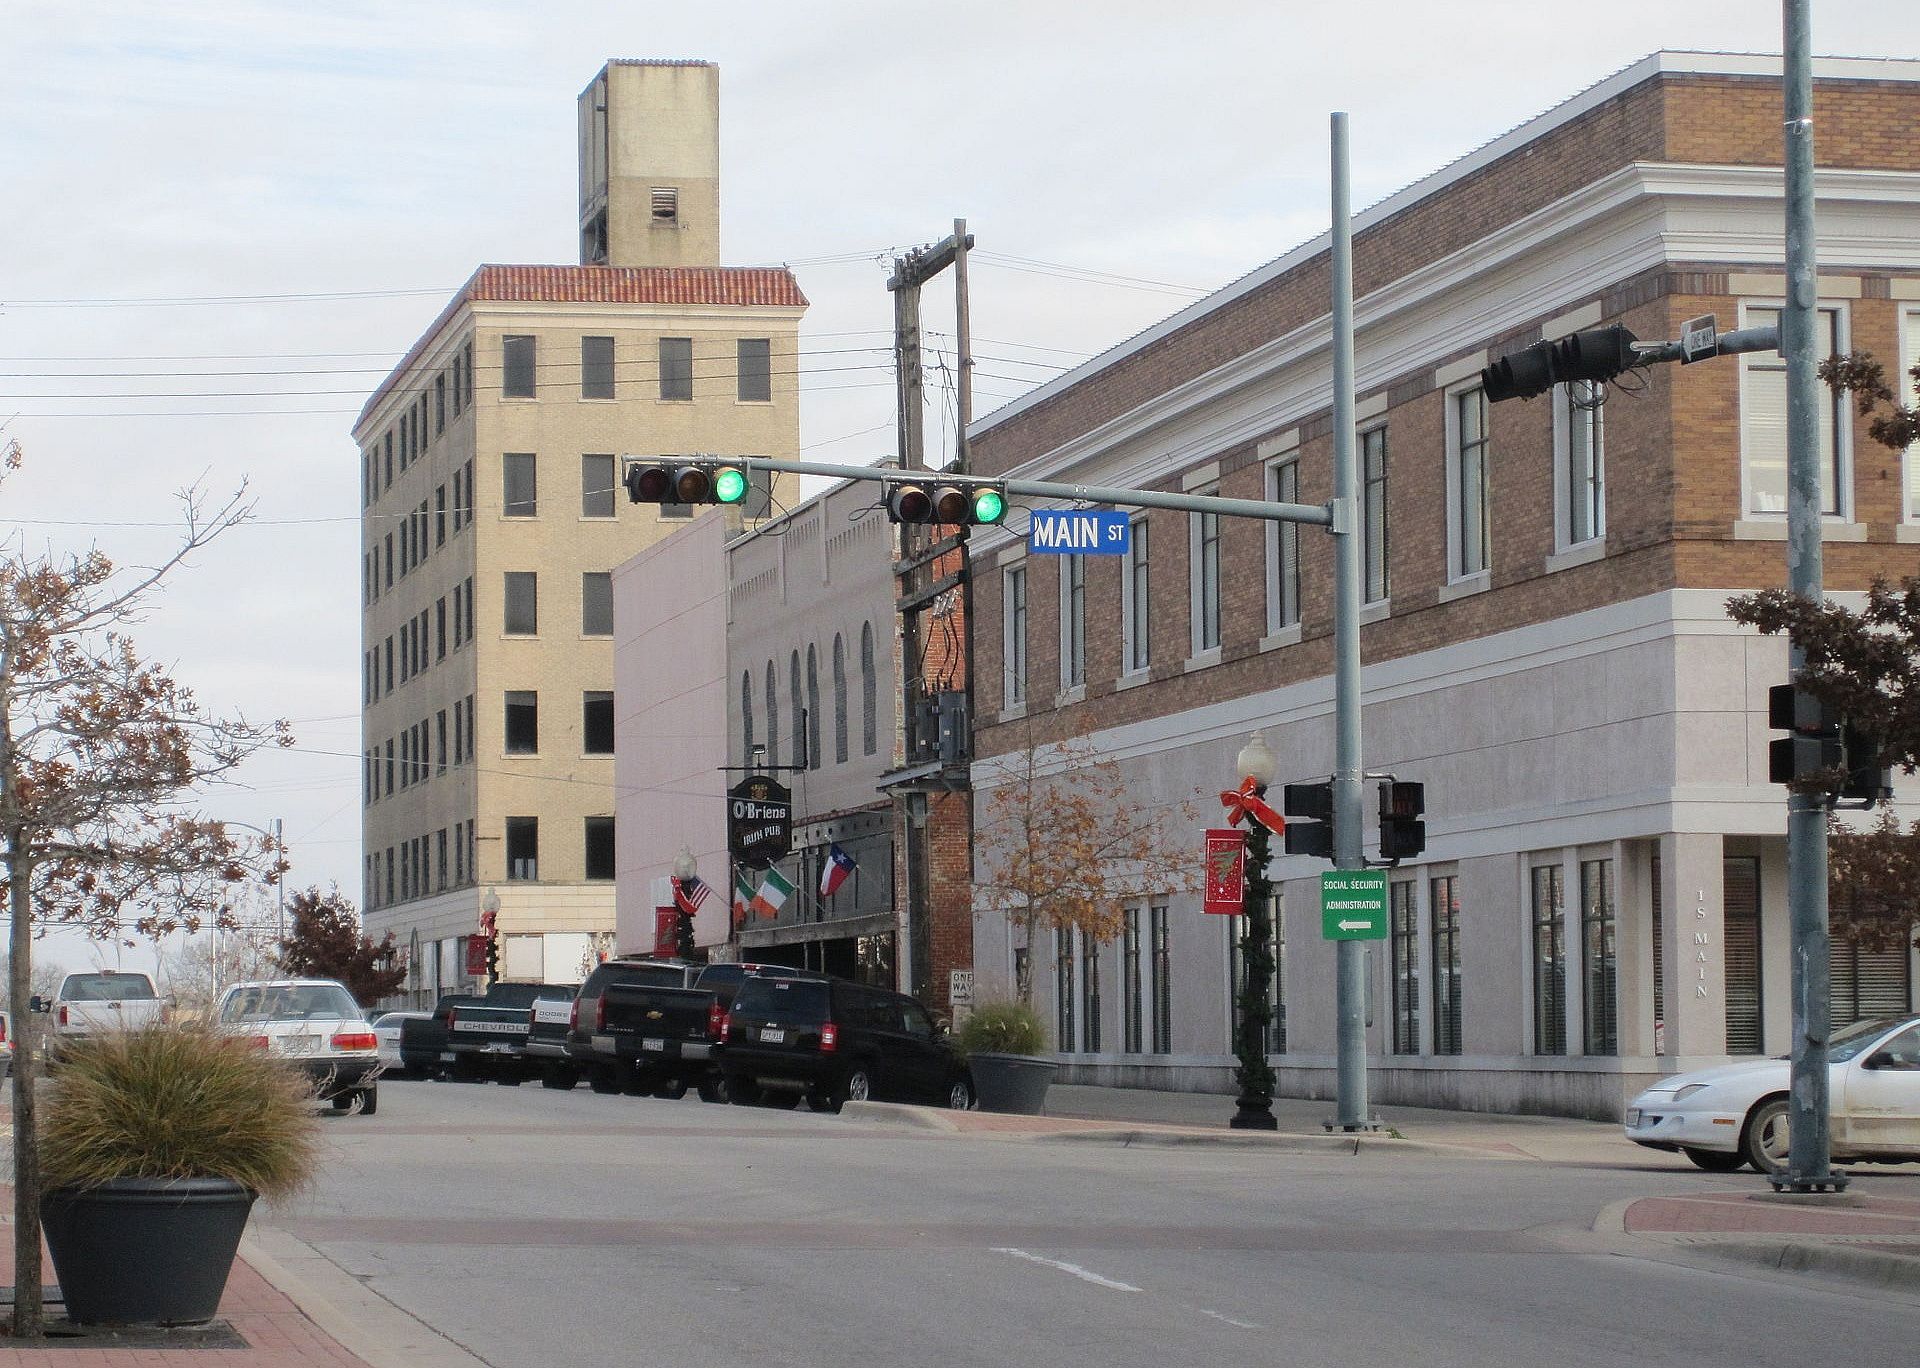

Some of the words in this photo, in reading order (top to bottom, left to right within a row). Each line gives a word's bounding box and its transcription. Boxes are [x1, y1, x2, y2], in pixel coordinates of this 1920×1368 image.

[1034, 516, 1098, 548] MAIN
[1108, 525, 1124, 541] ST
[733, 801, 786, 819] O'Briens
[764, 825, 781, 837] PUB
[1323, 880, 1349, 890] SOCIAL
[1350, 880, 1384, 890] SECURITY
[1326, 900, 1381, 910] ADMINISTRATION
[953, 973, 974, 981] ONE
[952, 982, 974, 991] WAY
[463, 1022, 530, 1032] CHEVROLE
